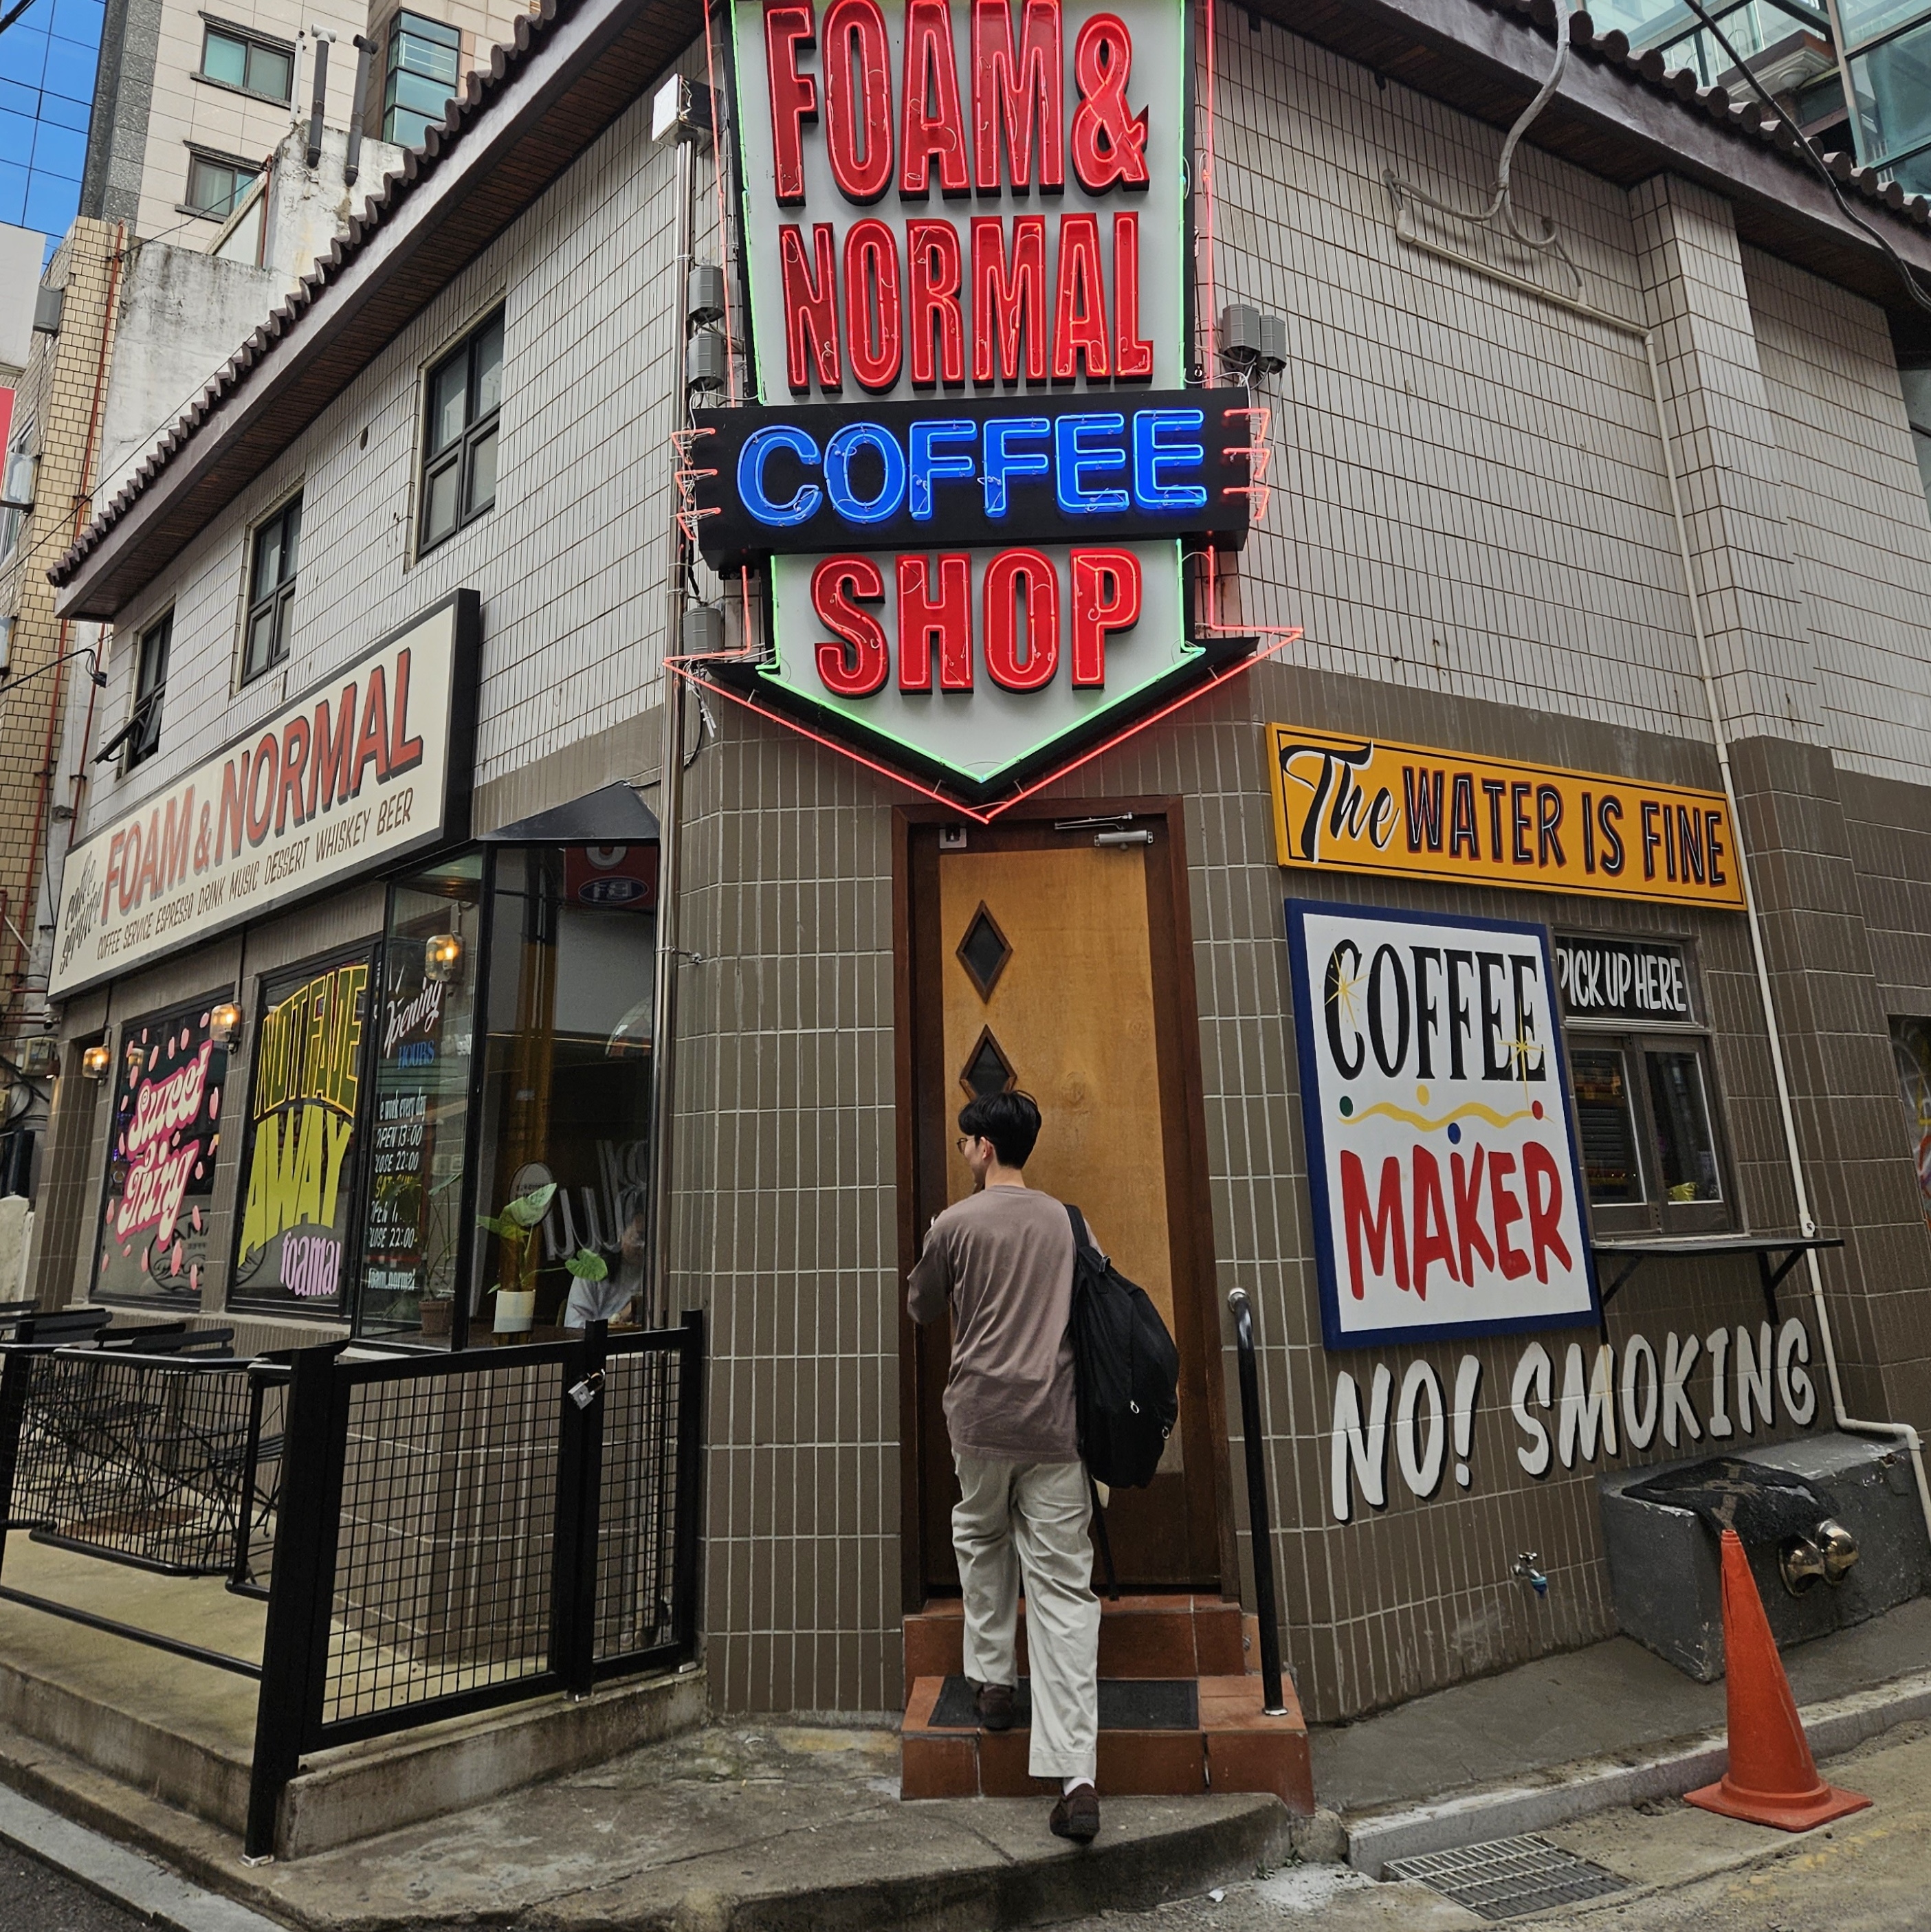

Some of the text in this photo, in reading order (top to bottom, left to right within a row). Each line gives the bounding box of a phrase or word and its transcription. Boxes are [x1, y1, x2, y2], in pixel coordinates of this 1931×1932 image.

[779, 212, 1153, 395] NORMAL
[737, 408, 1206, 526] COFFEE
[810, 549, 1142, 698] SHOP
[101, 647, 423, 926] FOAM & NORMAL
[1280, 739, 1726, 888] The WATER IS FINE
[97, 787, 414, 960] COFFEE SERVICE ESPRESSO DRINK MUSIC DESSERT WHISKEY BEER
[1325, 939, 1547, 1082] COFFEE
[1557, 948, 1687, 1012] PICK UP HERE
[128, 1041, 212, 1155] Sweet
[384, 1089, 399, 1120] work
[399, 1097, 415, 1123] every
[416, 1087, 427, 1122] day
[397, 1040, 434, 1069] HOURS
[116, 1141, 198, 1245] Thing
[238, 1104, 353, 1268] AWAY
[375, 1151, 419, 1173] LOSE 22:00
[398, 1124, 423, 1147] 13:00
[369, 1227, 415, 1248] LOSE 22:00
[1340, 1141, 1572, 1300] MAKER
[1332, 1317, 1816, 1520] NO! SMOKING
